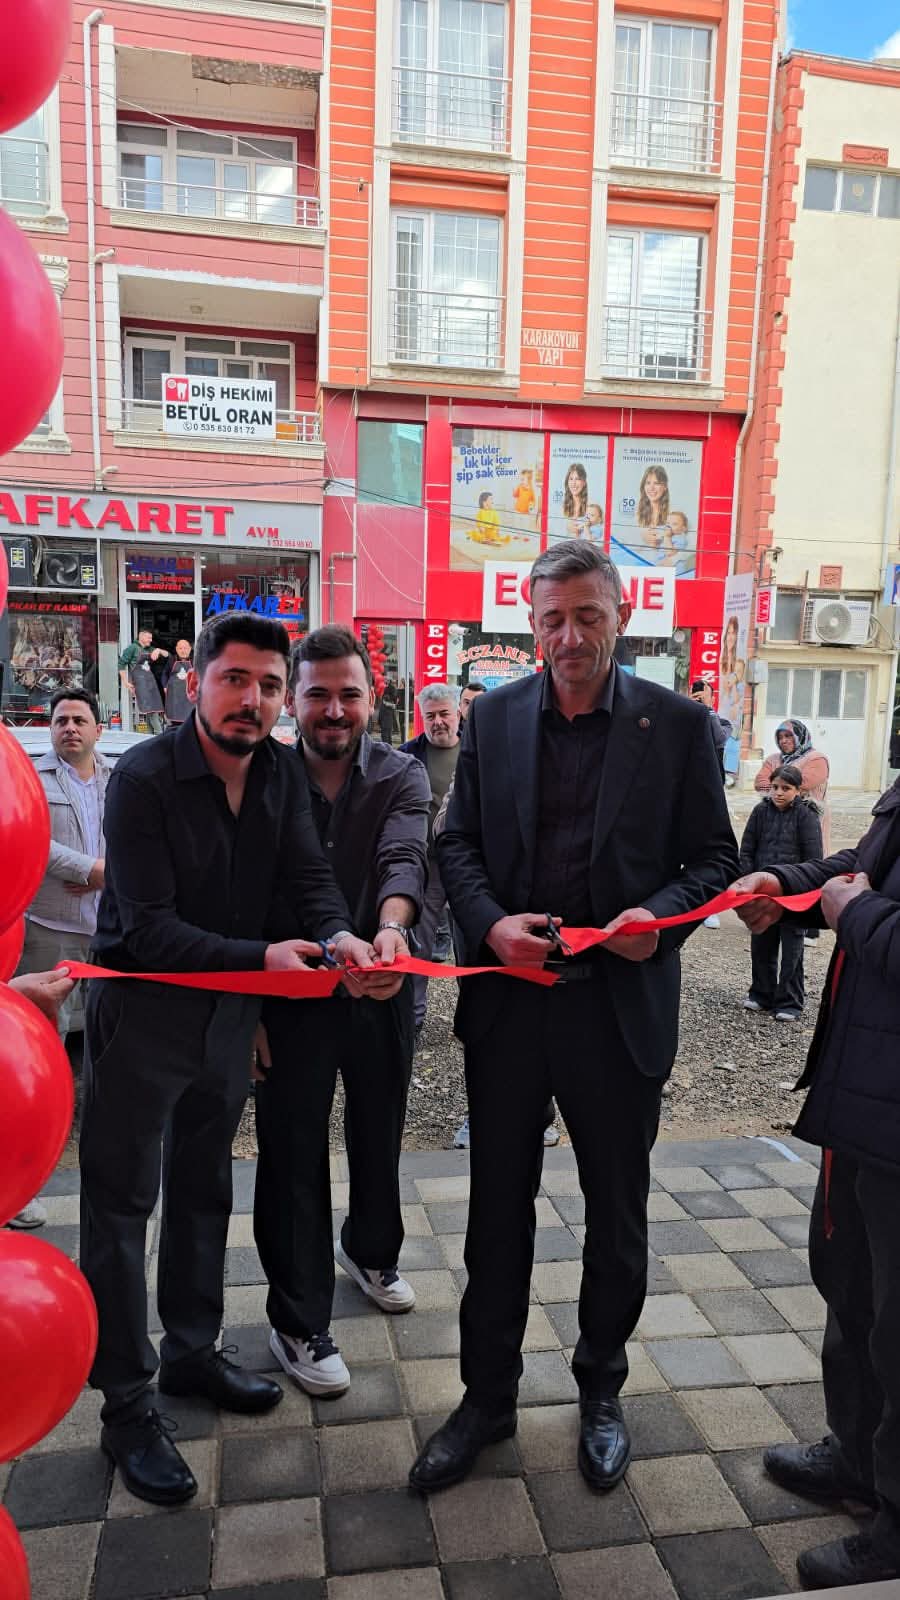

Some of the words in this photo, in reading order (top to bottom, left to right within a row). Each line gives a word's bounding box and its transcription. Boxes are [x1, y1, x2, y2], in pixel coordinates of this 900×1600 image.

[522, 329, 579, 349] KARAKOYUN
[537, 348, 564, 365] YAPI
[191, 382, 216, 401] DİŞ
[220, 386, 273, 402] HEKİMİ
[166, 403, 221, 422] BETÜL
[226, 408, 273, 426] ORAN
[201, 424, 215, 432] 535
[245, 426, 255, 434] 72
[460, 445, 501, 455] Bebekler
[464, 455, 478, 468] lık
[480, 455, 493, 466] lık
[495, 455, 512, 464] içer
[456, 469, 474, 484] şip
[475, 467, 493, 478] şak
[495, 468, 517, 477] çözer
[622, 497, 635, 507] 50
[0, 492, 234, 537] AFKARET
[246, 526, 279, 538] AVM
[206, 592, 304, 615] AFKARET
[456, 644, 531, 665] ECZANE
